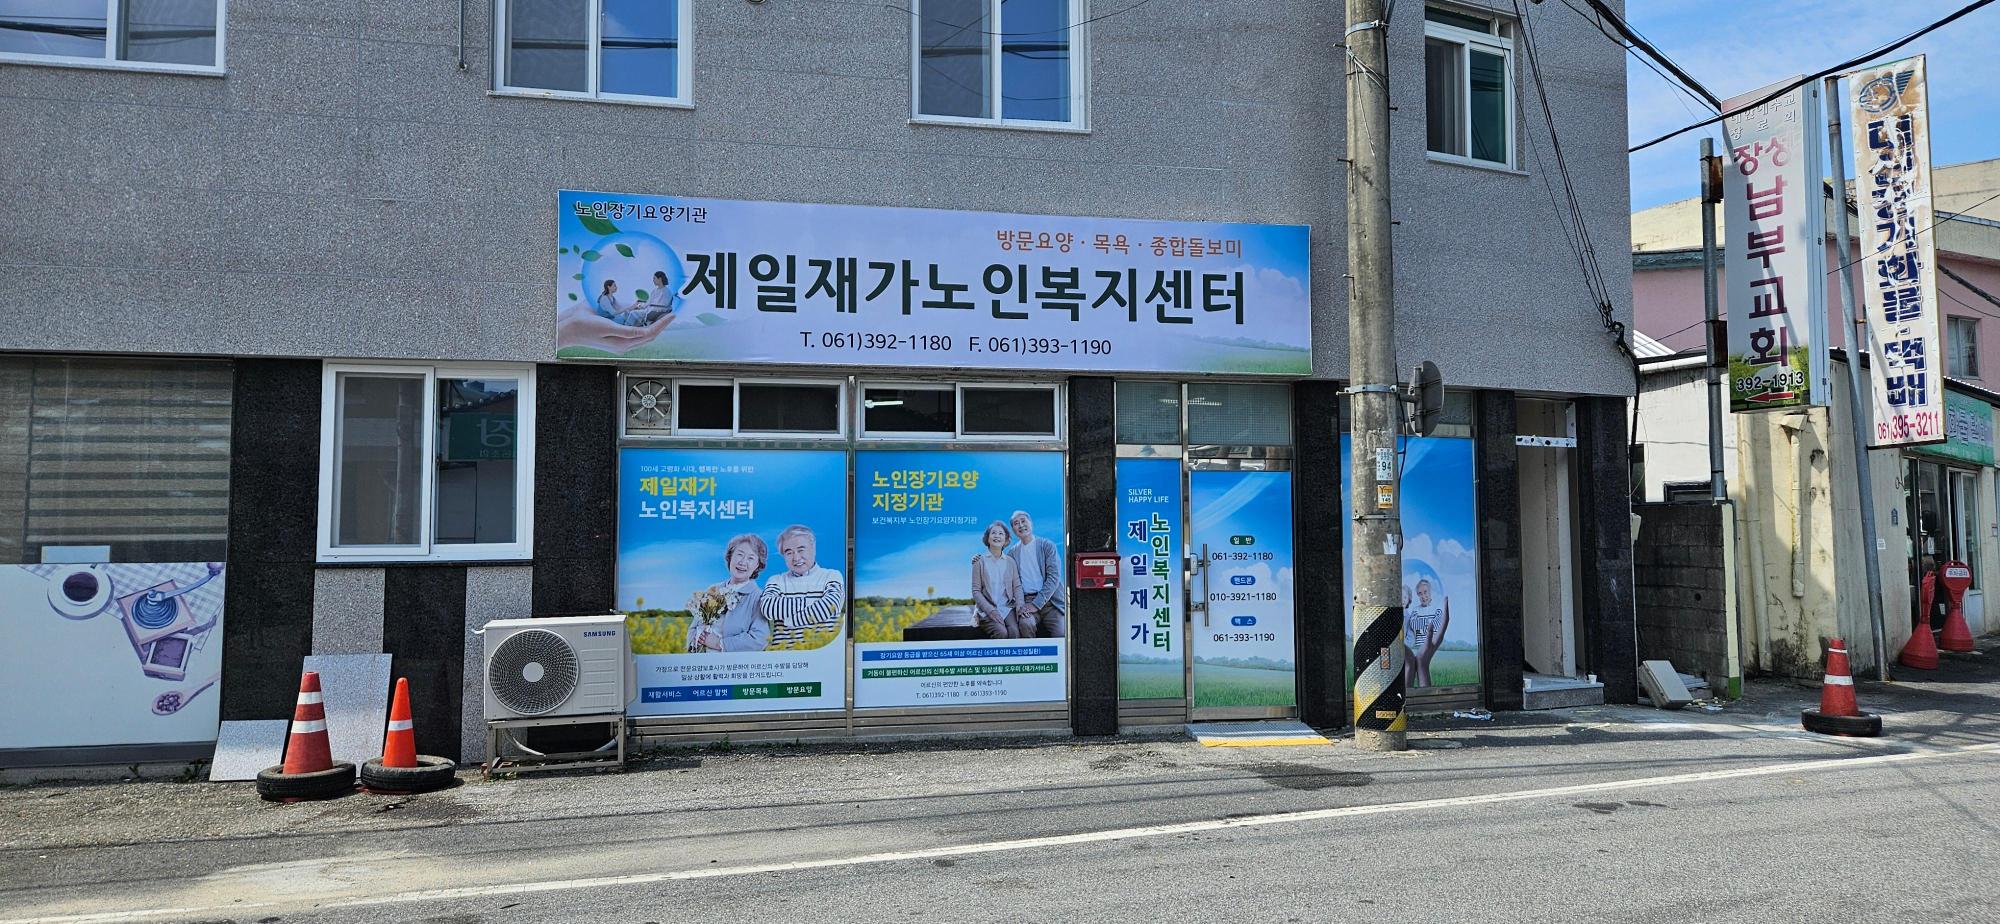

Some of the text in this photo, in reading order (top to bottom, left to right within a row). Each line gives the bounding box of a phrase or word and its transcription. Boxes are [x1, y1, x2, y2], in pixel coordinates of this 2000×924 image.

[575, 202, 708, 223] 노인장기요양기관
[997, 230, 1242, 259] 방문요양 목욕 종합돌보미
[1746, 175, 1789, 367] 남부교회
[682, 252, 1244, 325] 제일재가노인복지센터
[800, 331, 1112, 356] T. 061)392-1180 F. 061)393-1190
[1736, 371, 1804, 391] 392-1913
[1877, 411, 1940, 440] 061)395-3211
[741, 465, 754, 473] 위한
[639, 476, 717, 496] 제일재가
[872, 470, 979, 490] 노인장기요양
[872, 492, 944, 511] 지정기관
[1128, 488, 1153, 496] SILVER
[639, 500, 754, 520] 노인복지센터
[872, 516, 978, 525] 보건복지부 노인장기요양지정기관
[1211, 552, 1273, 560] 061-392-1180
[1128, 520, 1150, 644] 제일재가
[1150, 512, 1171, 652] 노인복지센터
[1234, 577, 1253, 585] 핸드폰
[1209, 592, 1277, 601] 010-3921-1180
[583, 630, 616, 638] SAMSUNG
[1213, 634, 1275, 642] 061-393-1190
[648, 690, 682, 698] 재활서비스
[742, 687, 769, 696] 방문목욕
[786, 685, 813, 694] 방문요양
